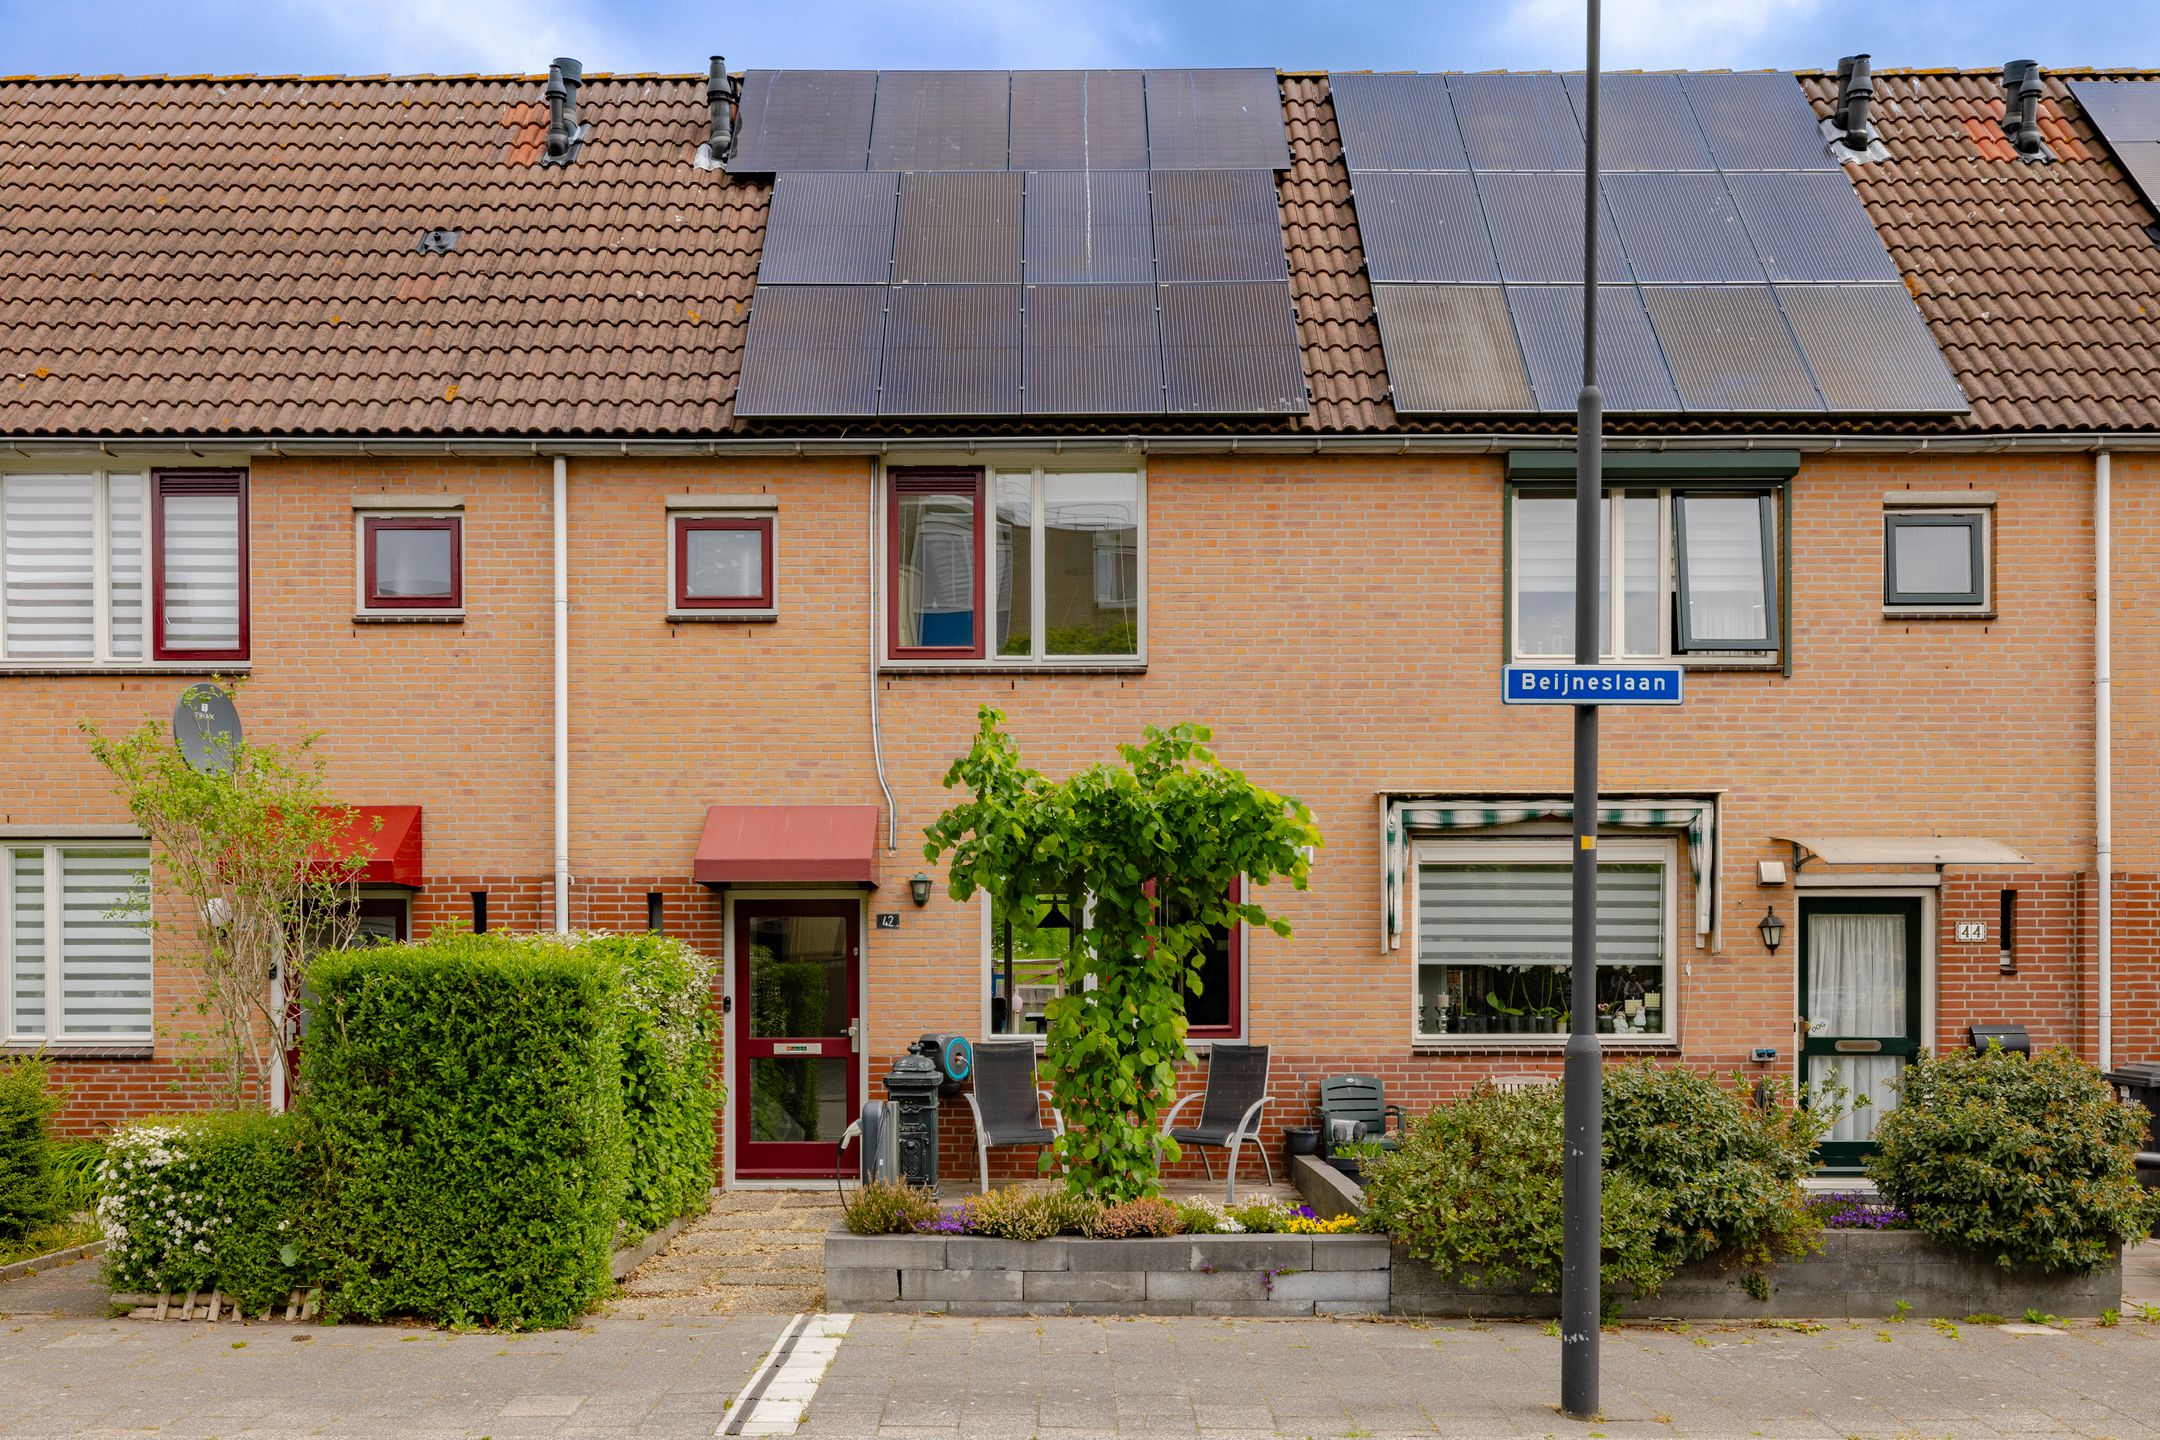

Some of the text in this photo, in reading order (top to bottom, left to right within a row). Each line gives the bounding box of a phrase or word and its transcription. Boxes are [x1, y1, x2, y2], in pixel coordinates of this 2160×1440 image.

[1521, 673, 1665, 696] Beijneslaan
[882, 915, 895, 927] 42
[1961, 925, 1981, 938] 44
